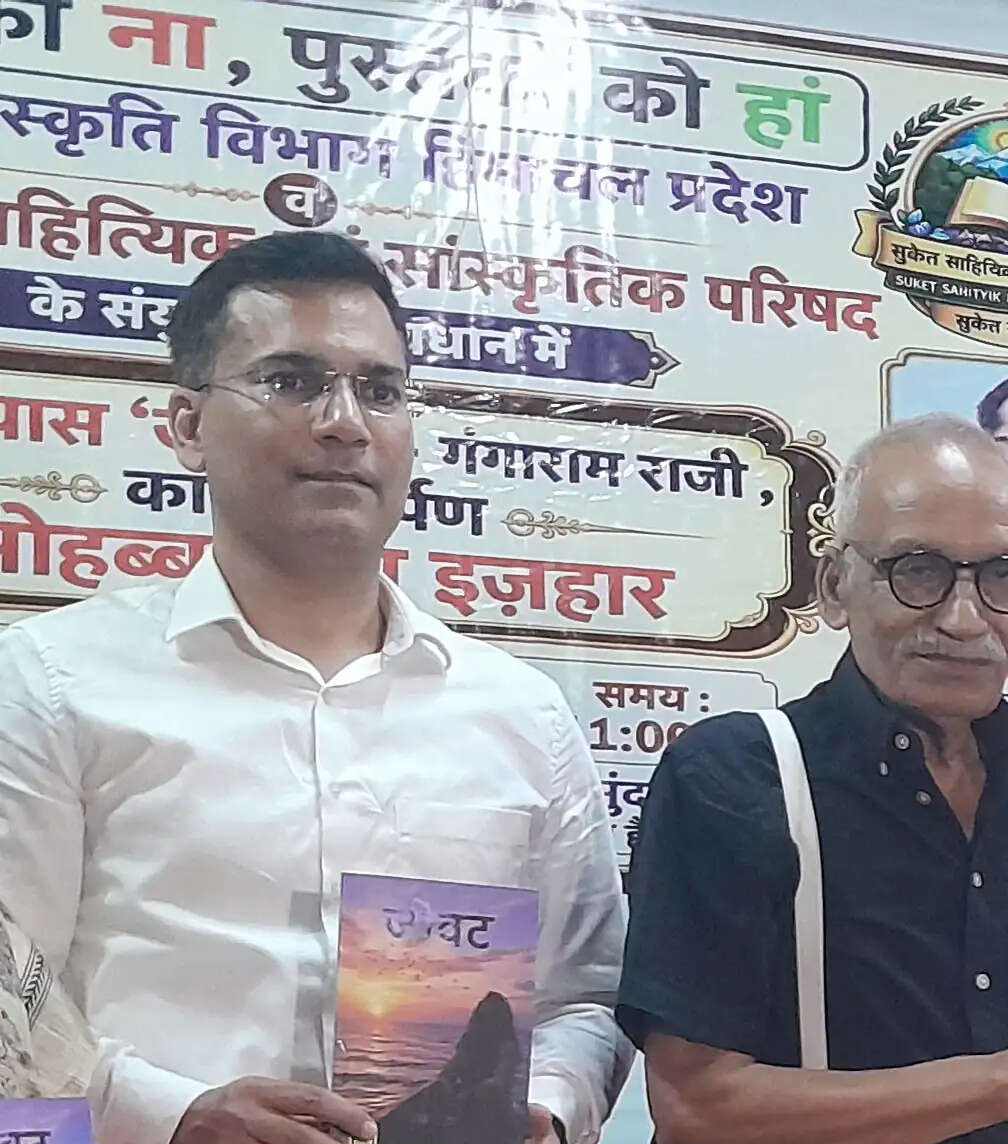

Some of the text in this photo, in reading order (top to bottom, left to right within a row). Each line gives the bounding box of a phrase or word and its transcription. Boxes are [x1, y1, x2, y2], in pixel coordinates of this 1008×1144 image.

[600, 57, 710, 129] को
[736, 76, 831, 150] हां
[0, 93, 180, 157] स्कृति
[666, 161, 808, 225] प्रदेश
[25, 276, 85, 323] के
[531, 325, 571, 370] में
[705, 266, 881, 339] परिषद
[895, 275, 937, 294] SUKET
[942, 283, 1001, 303] SAHITYIK
[438, 426, 625, 488] गंगाराम
[428, 551, 675, 623] इज़हार
